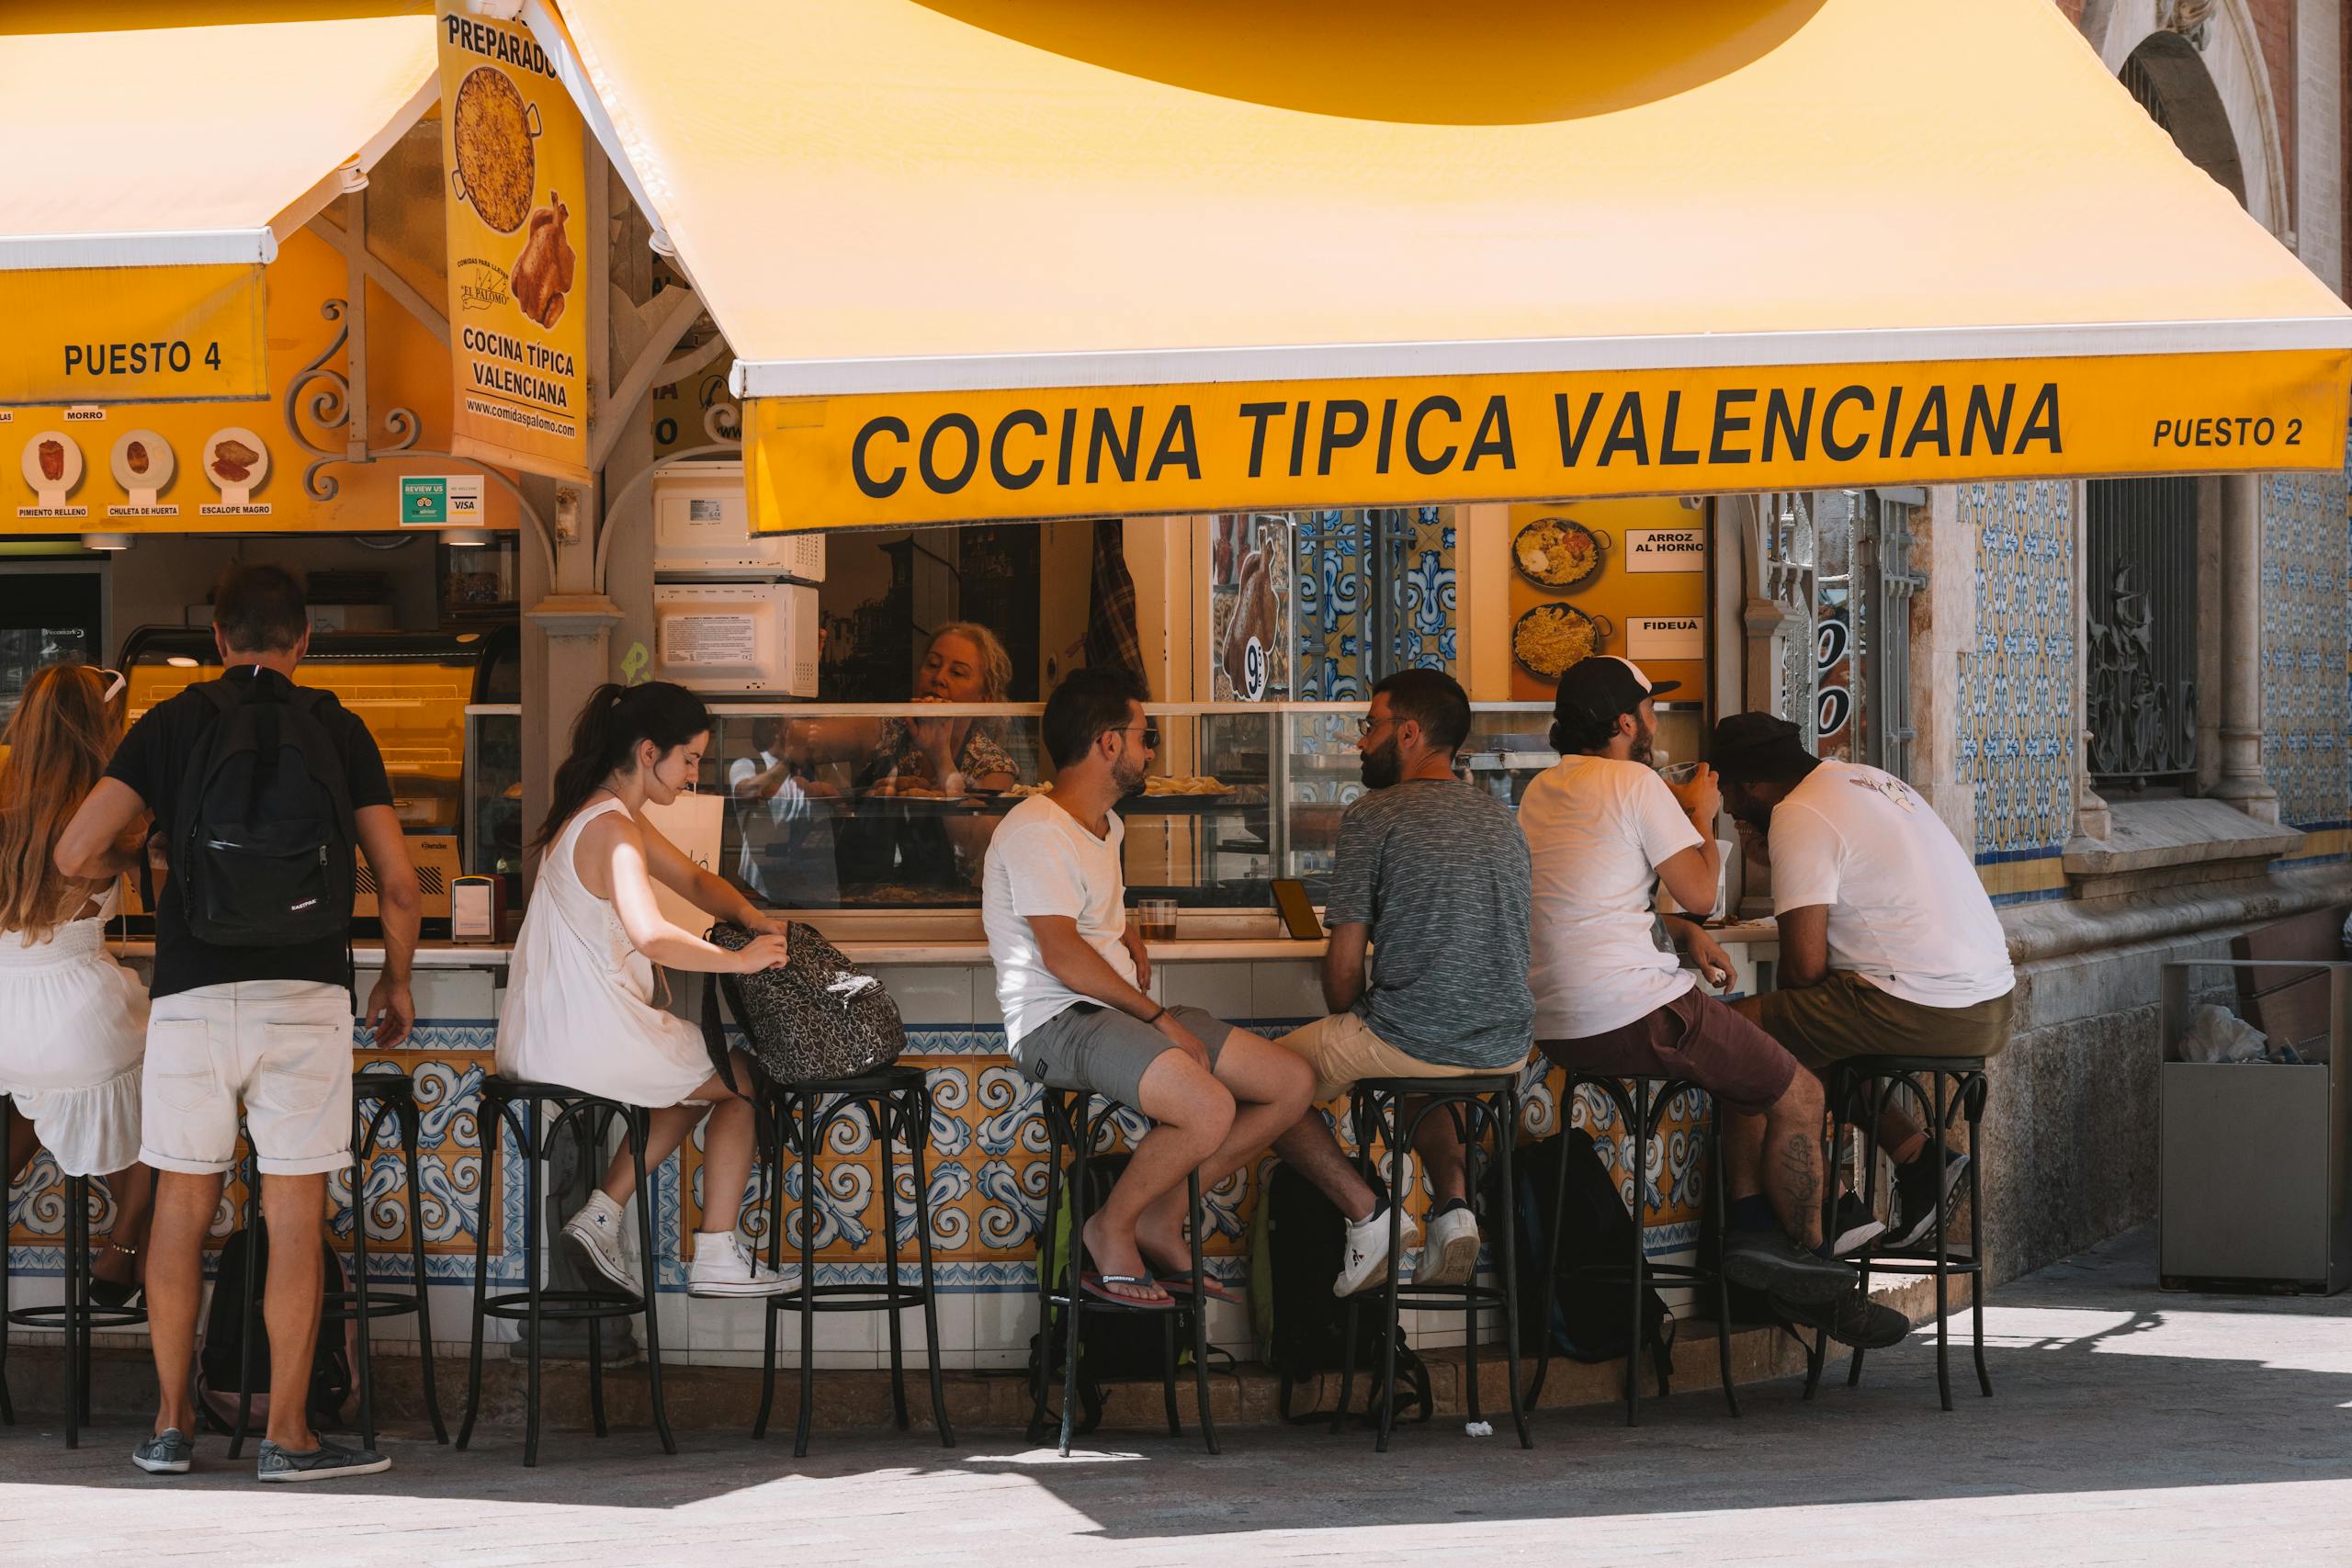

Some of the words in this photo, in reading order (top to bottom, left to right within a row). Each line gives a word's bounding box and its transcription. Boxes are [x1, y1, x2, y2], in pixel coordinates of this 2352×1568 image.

[458, 258, 478, 267] COMIDAS
[478, 259, 491, 267] PARA
[64, 341, 191, 375] PUESTO
[204, 342, 221, 371] 4
[463, 327, 523, 363] COCINA
[526, 343, 574, 378] TÍPICA
[473, 362, 568, 408] VALENCIANA
[466, 398, 575, 437] www.comidaspalomo.com
[2154, 417, 2275, 447] PUESTO
[2285, 418, 2302, 445] 2
[851, 404, 1202, 500] COCINA
[1237, 394, 1518, 478] TIPICA
[1555, 382, 2064, 468] VALENCIANA
[109, 507, 139, 515] CHULETA
[201, 506, 241, 514] ESCALOPE
[455, 501, 474, 510] VISA
[54, 508, 86, 516] RELLENO
[1647, 534, 1693, 542] ARROZ
[1635, 544, 1653, 552] AL
[1657, 543, 1703, 552] HORNO
[1644, 619, 1698, 630] FIDEUÀ
[291, 898, 317, 911] EASTPAK
